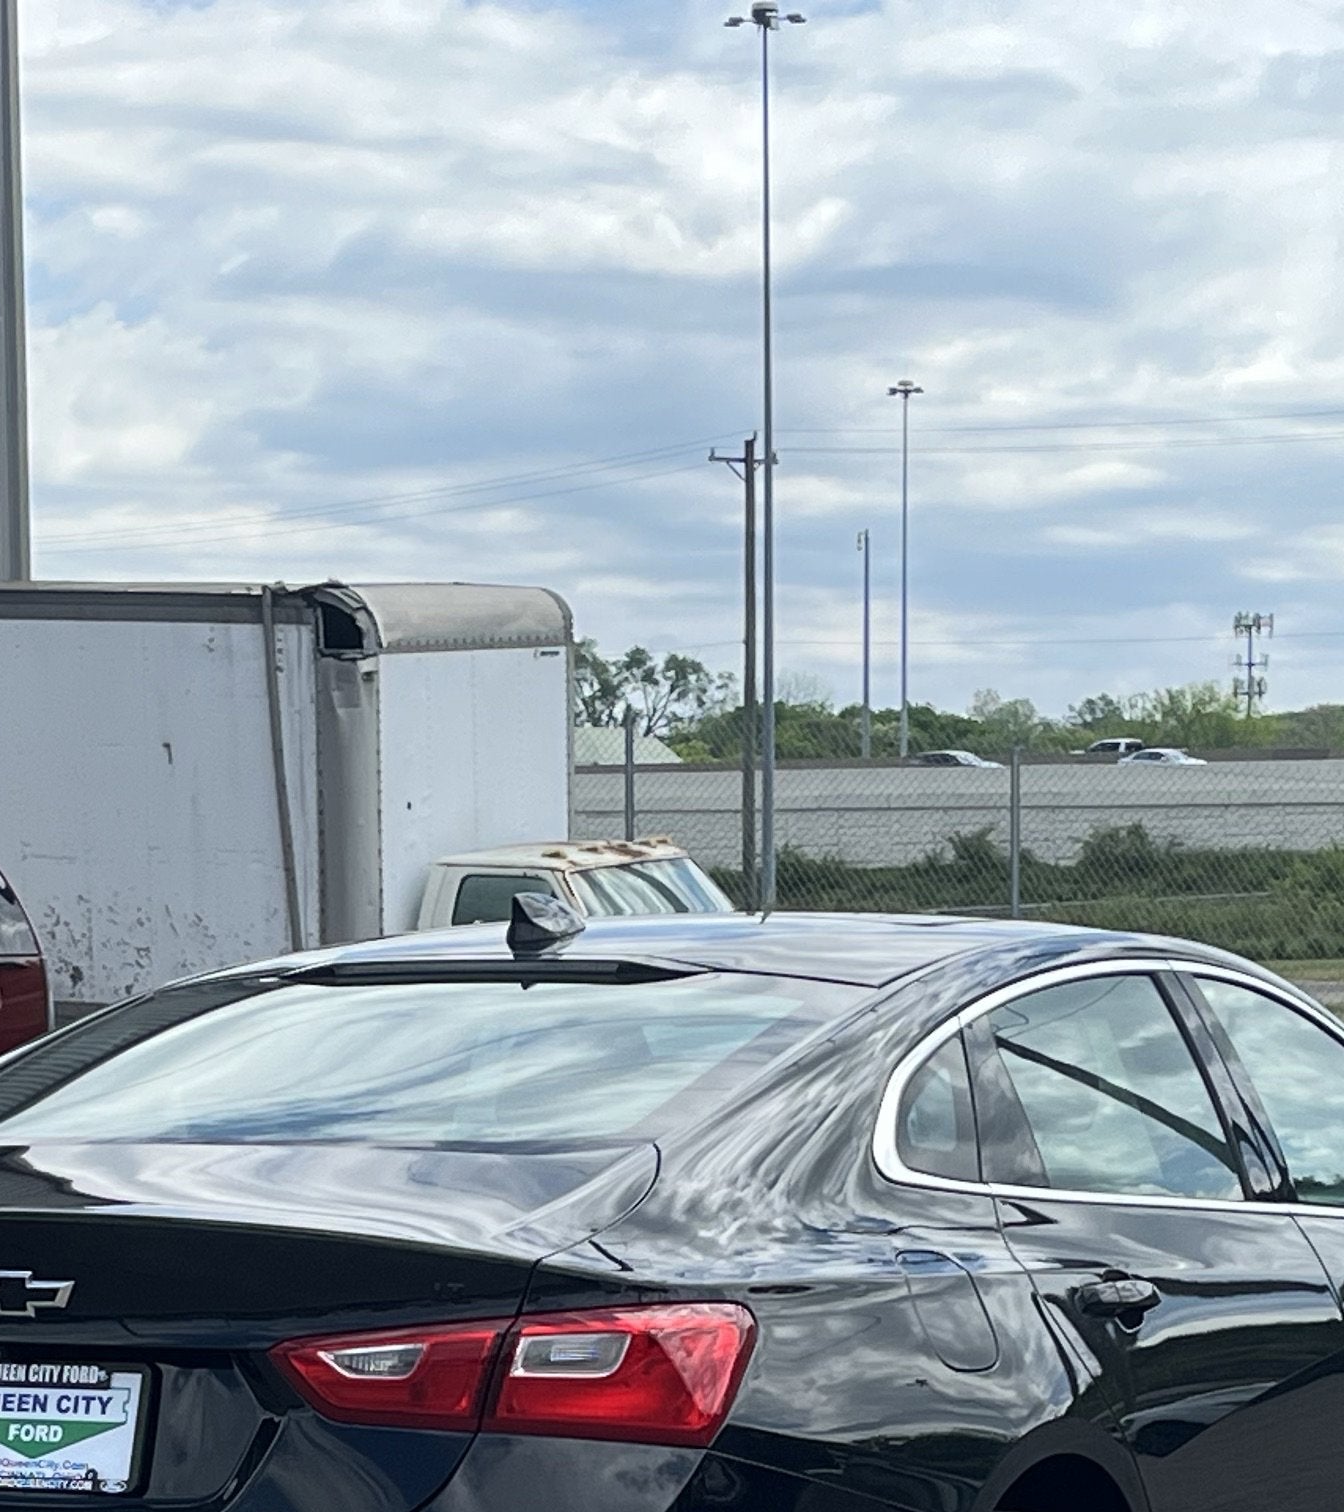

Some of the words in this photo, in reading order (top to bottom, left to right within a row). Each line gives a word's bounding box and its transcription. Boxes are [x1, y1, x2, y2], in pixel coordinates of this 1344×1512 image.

[29, 1364, 60, 1383] CITY
[62, 1365, 98, 1384] FORD
[56, 1395, 113, 1415] CITY
[8, 1423, 63, 1442] FORD
